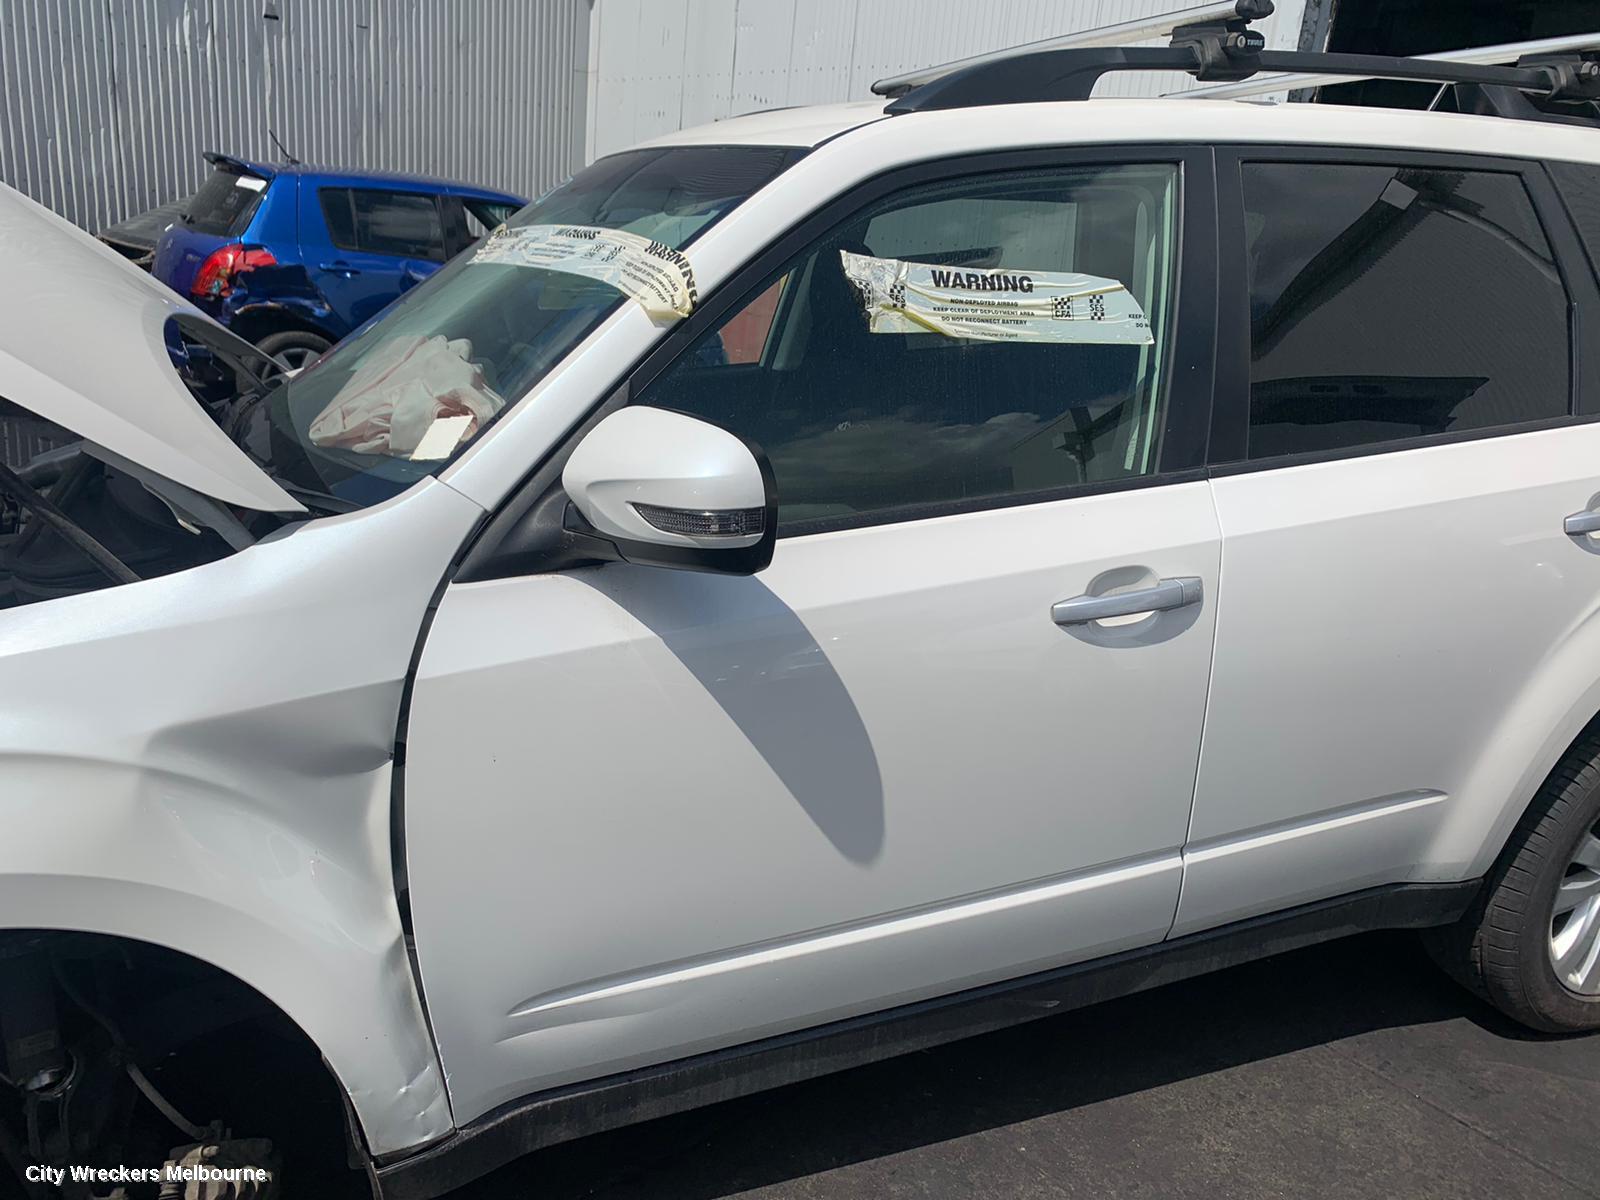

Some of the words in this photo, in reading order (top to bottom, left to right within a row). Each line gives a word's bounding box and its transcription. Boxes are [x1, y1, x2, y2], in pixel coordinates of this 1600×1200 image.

[931, 270, 1034, 293] WARNING
[1089, 304, 1104, 312] SES
[1055, 310, 1071, 318] CFA
